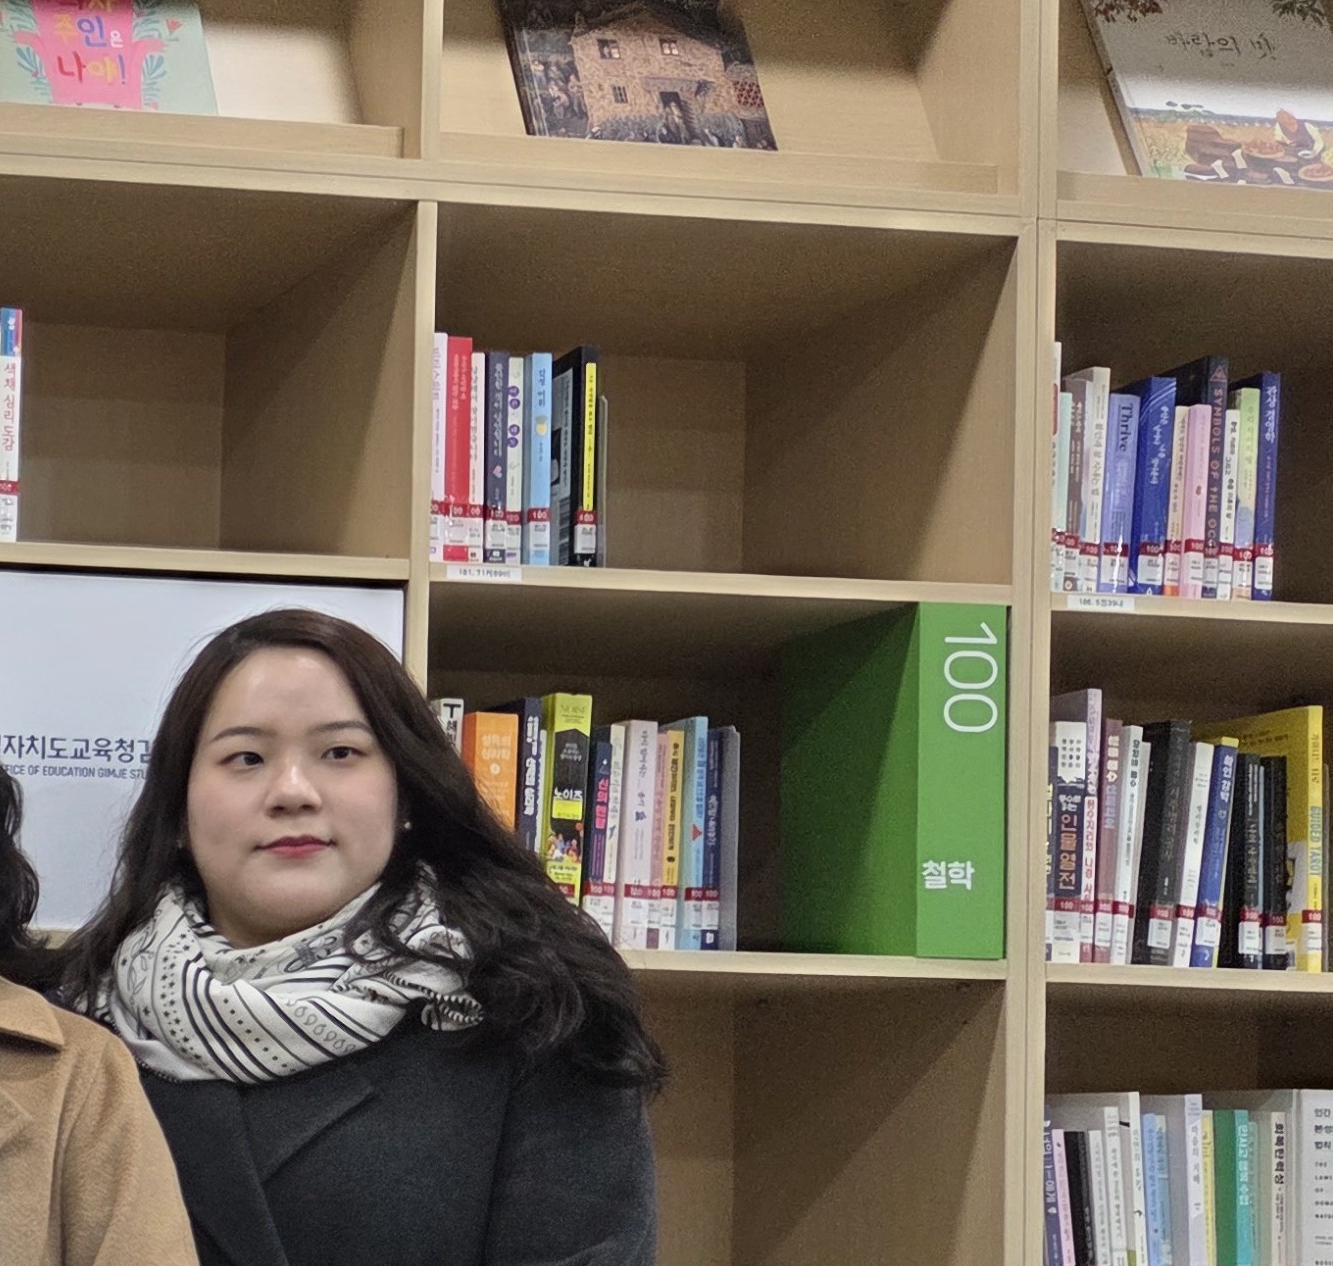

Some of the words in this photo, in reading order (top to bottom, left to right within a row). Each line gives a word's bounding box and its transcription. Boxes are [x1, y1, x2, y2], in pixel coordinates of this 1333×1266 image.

[1118, 404, 1134, 452] Thrive
[1211, 461, 1221, 480] OF
[1209, 485, 1220, 514] THE
[943, 621, 998, 733] 100
[28, 767, 39, 775] OF
[43, 765, 95, 778] EDUCATION
[98, 768, 127, 779] GIMJE
[922, 860, 975, 890] 철학
[663, 888, 675, 897] 100
[1274, 1123, 1285, 1185] 회복탄력성
